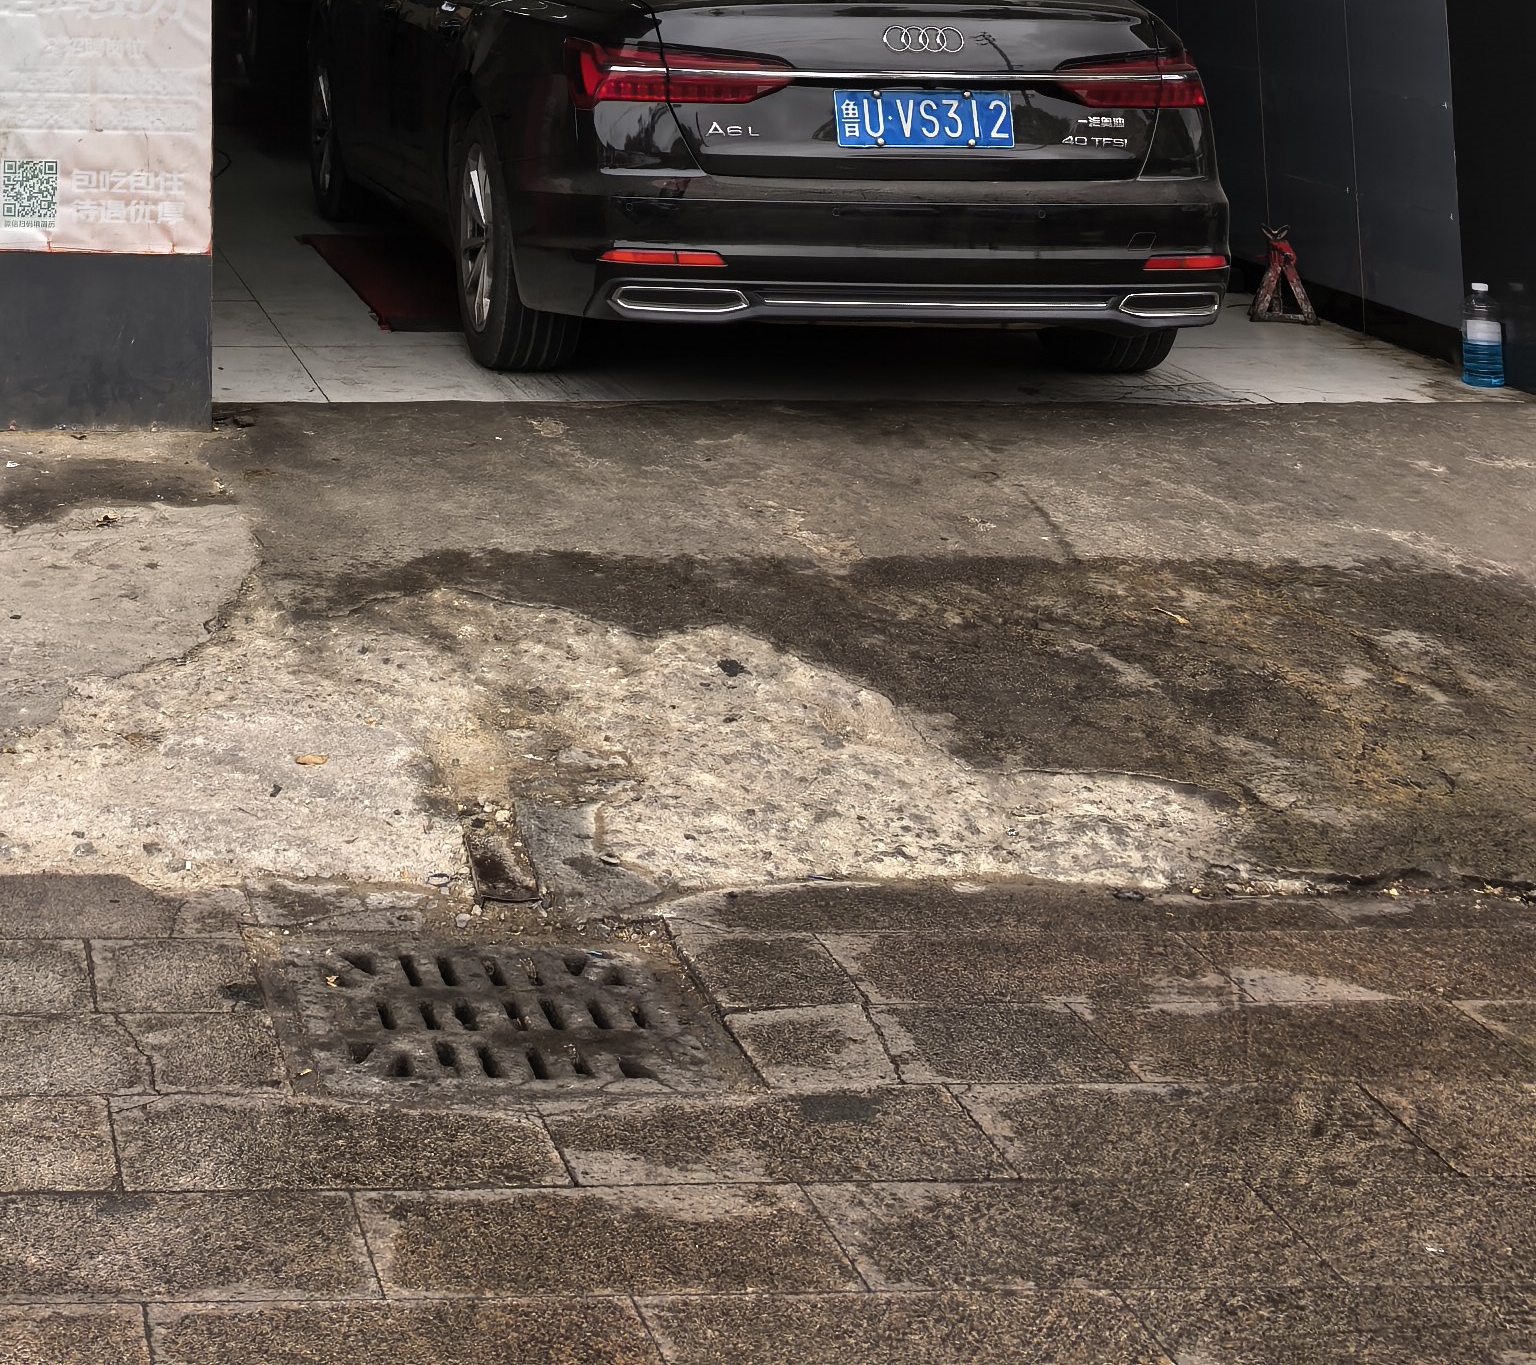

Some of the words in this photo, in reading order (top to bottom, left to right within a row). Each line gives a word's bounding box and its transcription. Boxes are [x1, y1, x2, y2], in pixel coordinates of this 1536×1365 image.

[1062, 135, 1088, 146] 40
[1090, 136, 1128, 148] TFSI
[71, 168, 186, 196] 包吃包住
[71, 199, 186, 225] 待遇优厚
